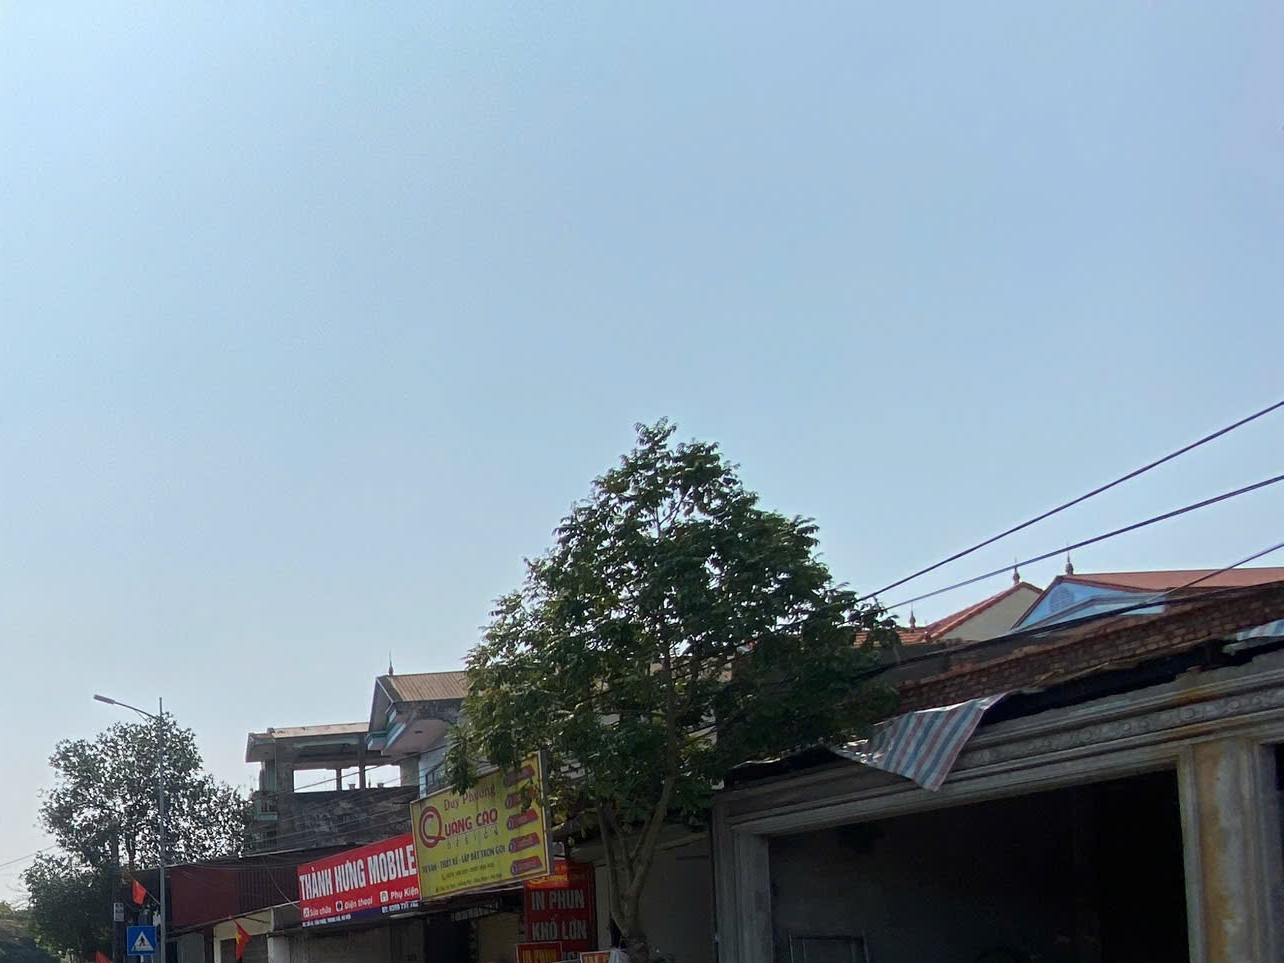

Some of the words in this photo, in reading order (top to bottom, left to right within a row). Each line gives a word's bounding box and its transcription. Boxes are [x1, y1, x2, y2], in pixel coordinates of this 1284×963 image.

[444, 798, 459, 811] Duy
[476, 807, 498, 826] CÁO
[300, 867, 333, 900] THÀNH
[367, 844, 417, 885] MOBILE
[531, 890, 545, 911] IN
[549, 888, 585, 910] PHUN
[531, 913, 558, 941] KHỔ
[561, 915, 588, 940] LỚN
